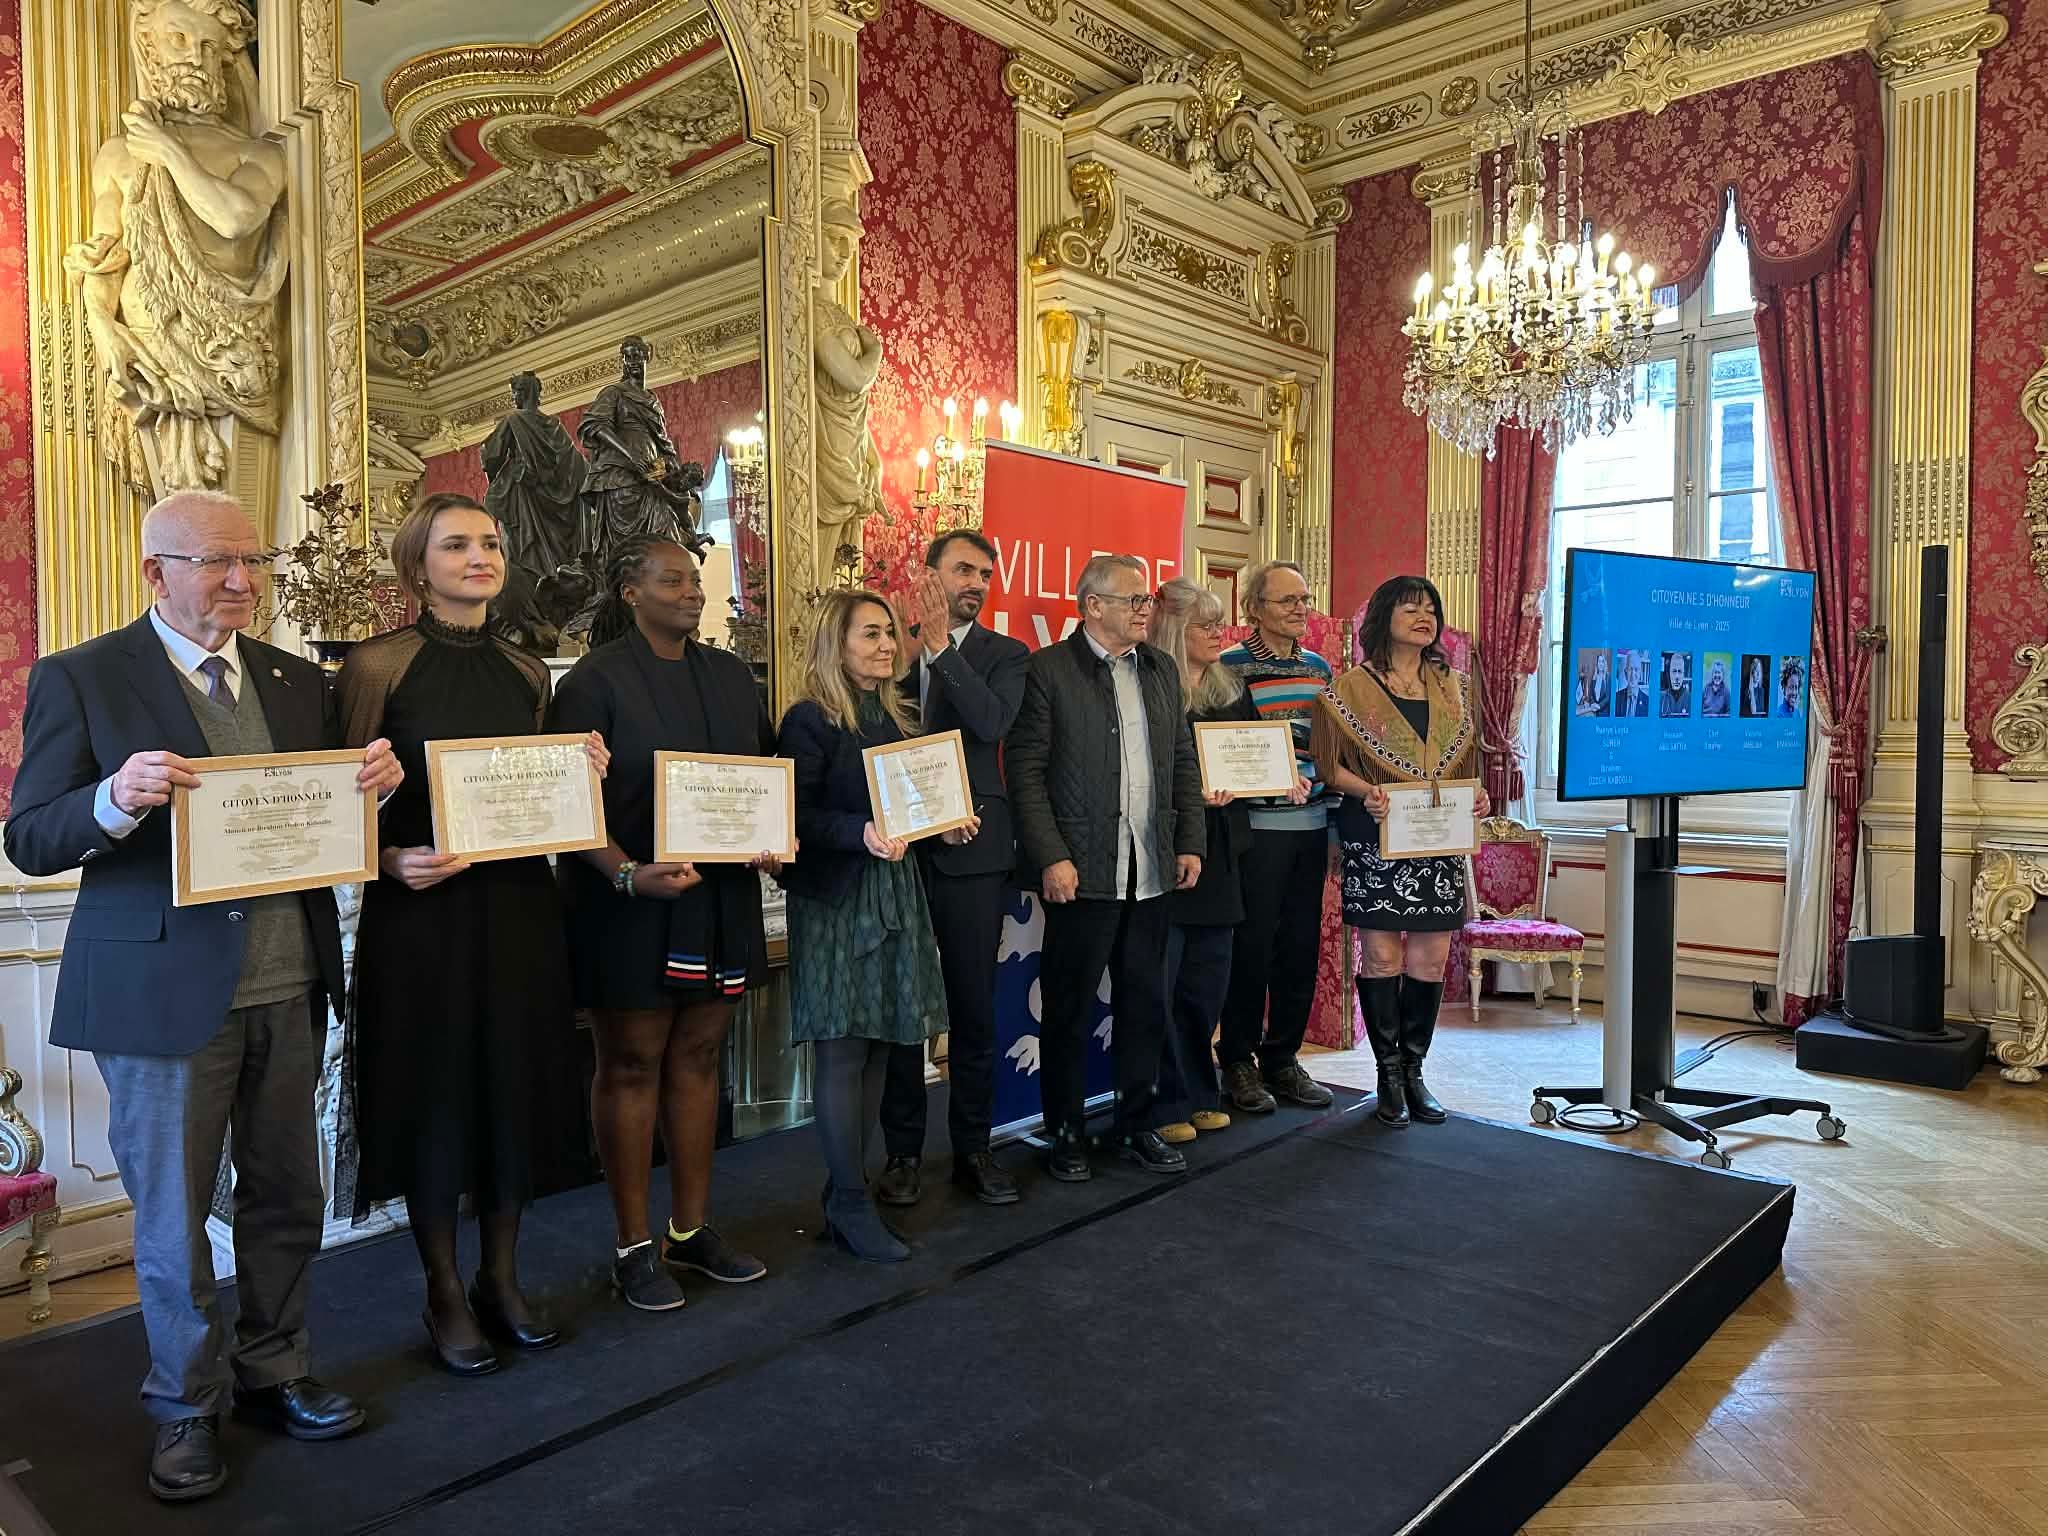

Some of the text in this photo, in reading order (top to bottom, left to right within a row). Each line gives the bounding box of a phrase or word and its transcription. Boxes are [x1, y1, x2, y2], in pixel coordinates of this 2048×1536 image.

[993, 537, 1112, 600] VILL
[1706, 593, 1750, 609] D'HONNEUR
[222, 791, 332, 808] CITOYEN D'HONNEUR
